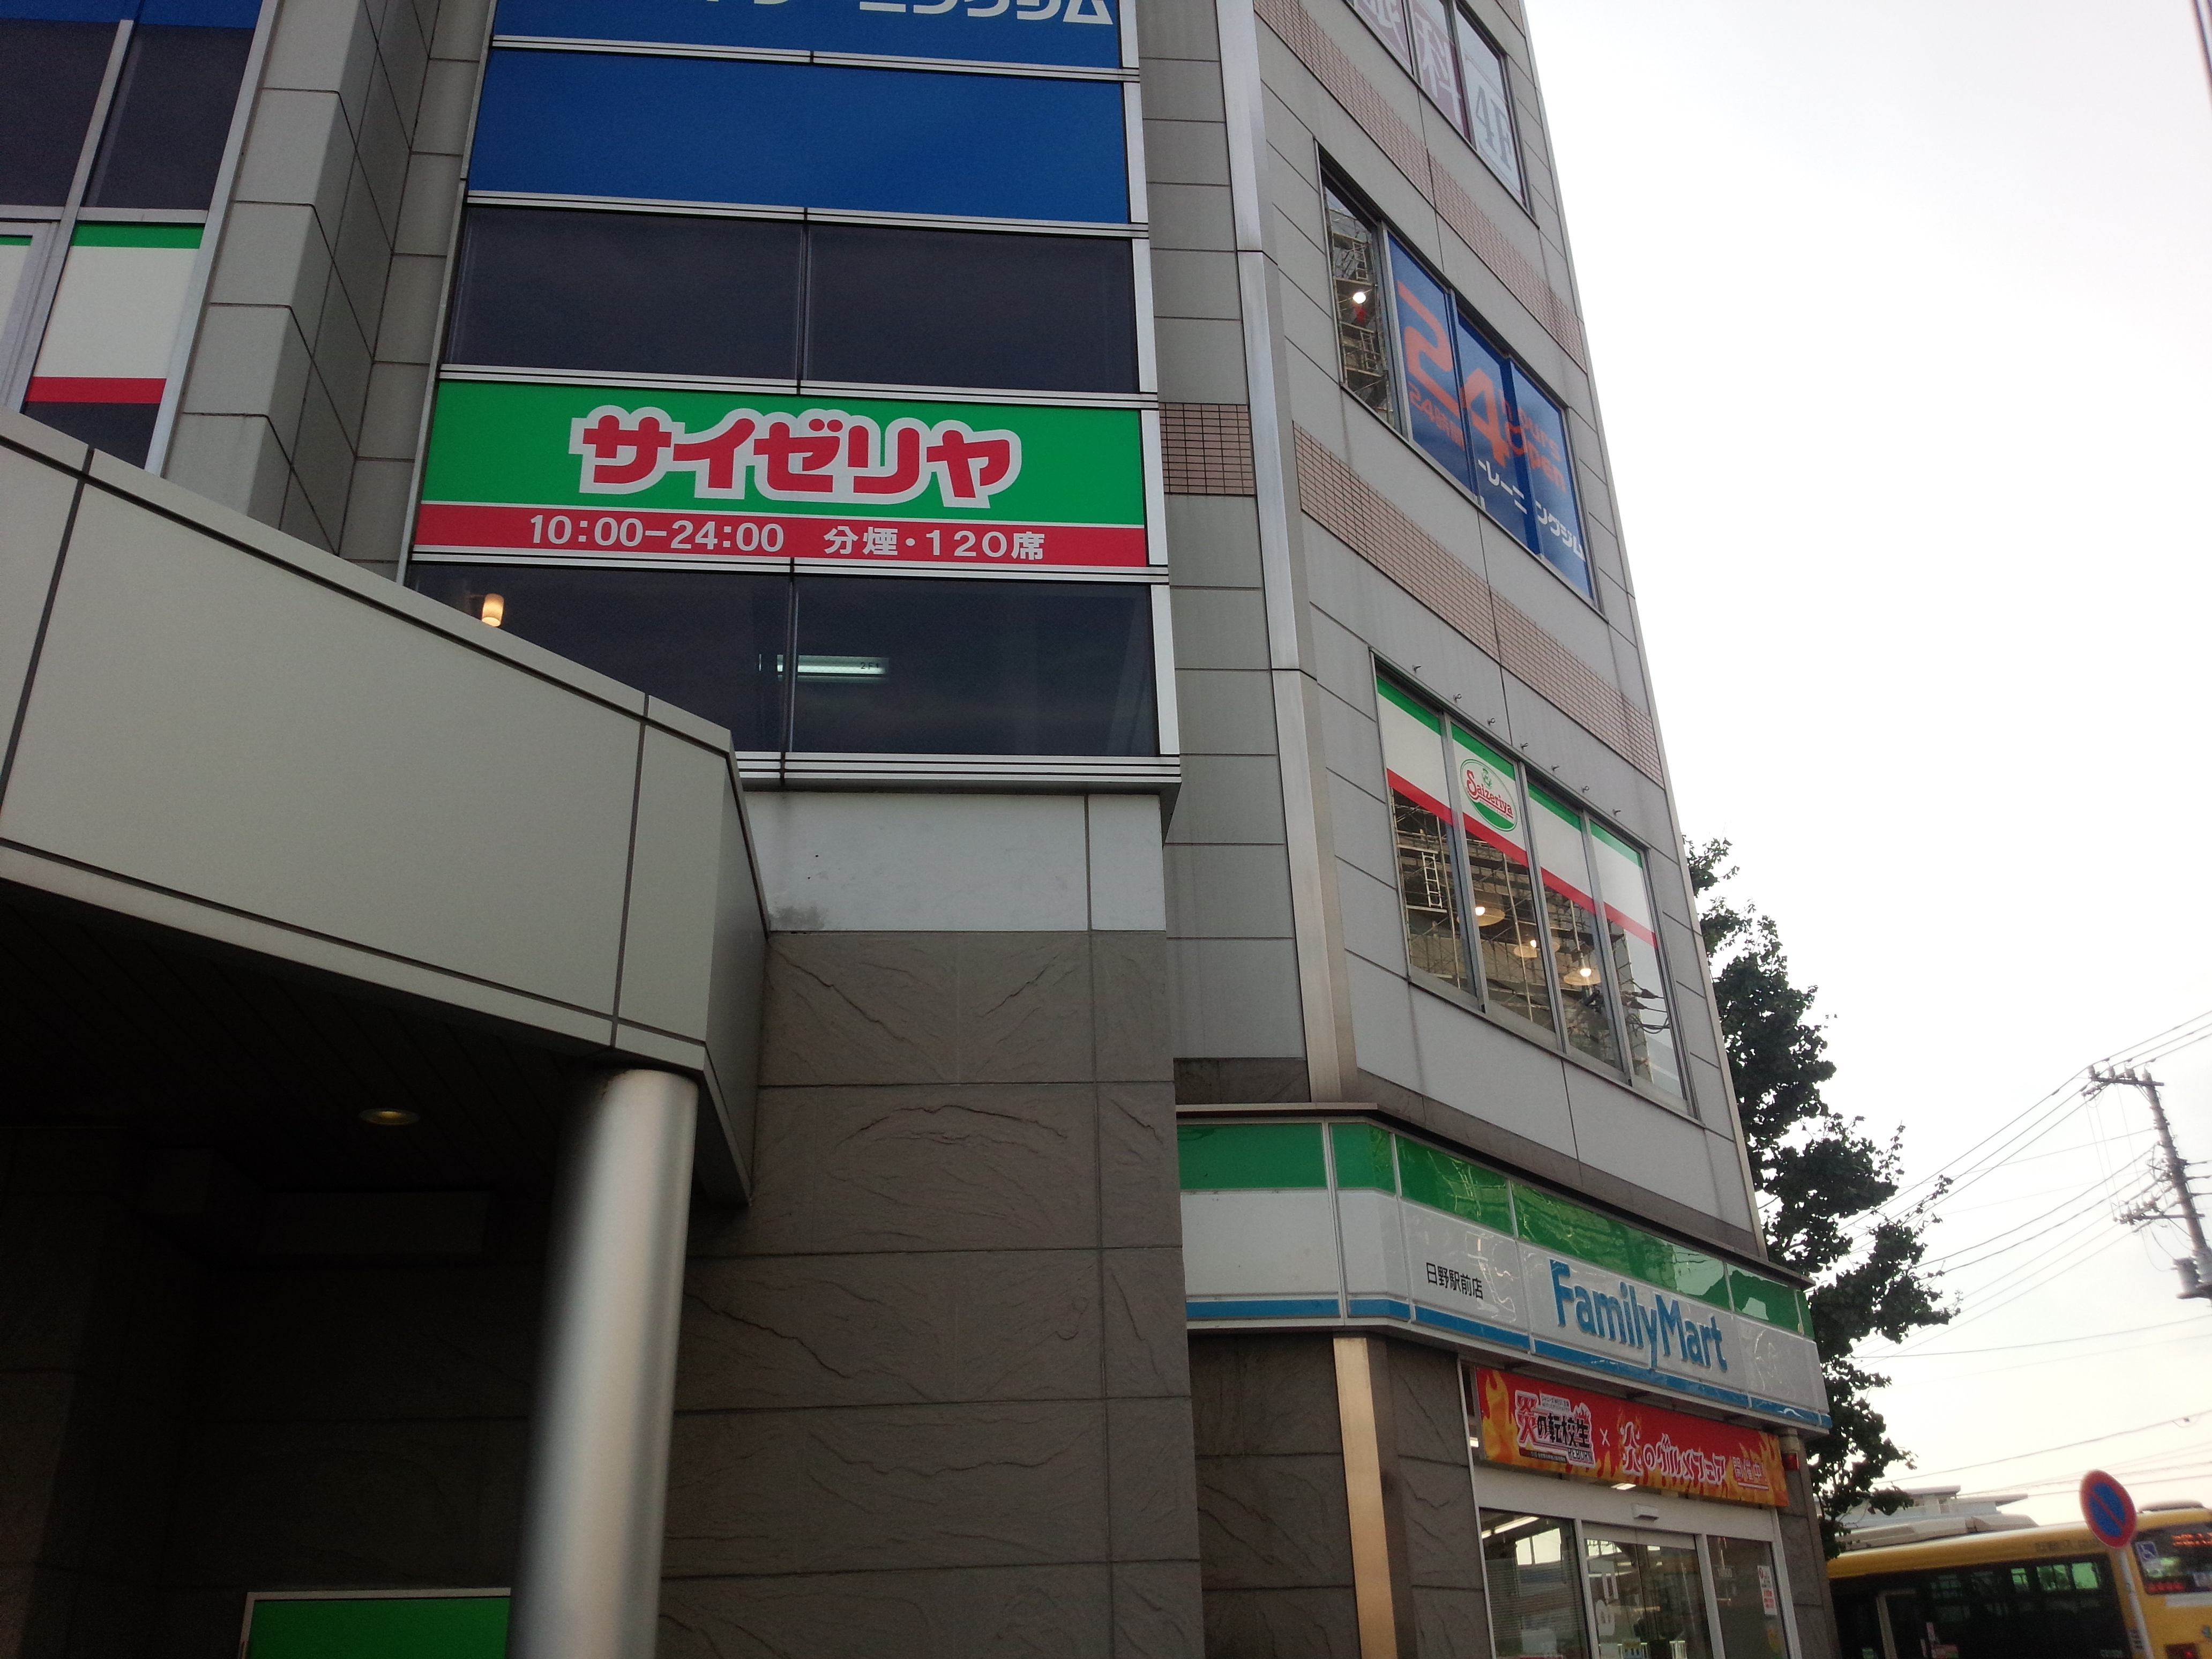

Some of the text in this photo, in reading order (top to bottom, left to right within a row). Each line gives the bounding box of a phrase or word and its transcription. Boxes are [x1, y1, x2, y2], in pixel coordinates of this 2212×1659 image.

[1397, 281, 1509, 468] 24
[571, 406, 1021, 507] サイゼリヤ
[860, 662, 875, 670] 2F
[1466, 769, 1514, 816] Saizeriya
[1426, 1261, 1484, 1299] 日野駅前店
[1549, 1257, 1728, 1372] FamilyMart
